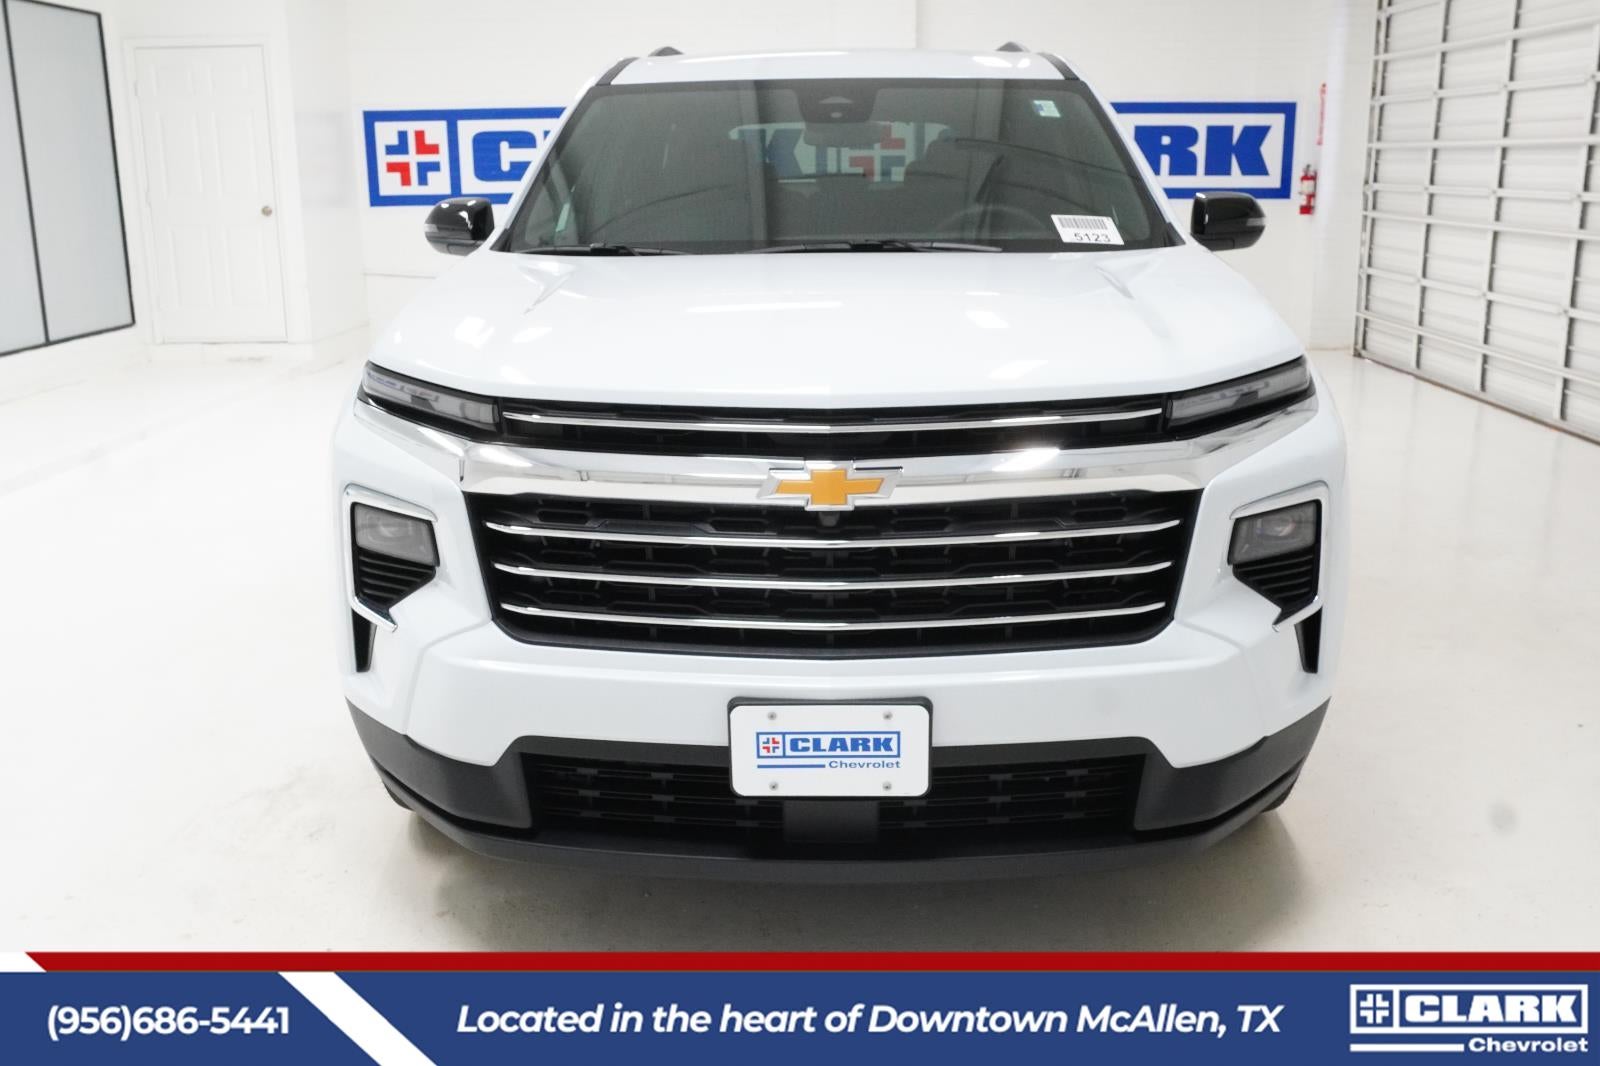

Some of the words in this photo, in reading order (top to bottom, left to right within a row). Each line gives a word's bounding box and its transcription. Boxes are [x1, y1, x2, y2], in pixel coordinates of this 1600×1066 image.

[1074, 232, 1111, 242] 5123
[789, 737, 893, 752] CLARK
[828, 760, 901, 769] Chevrolet
